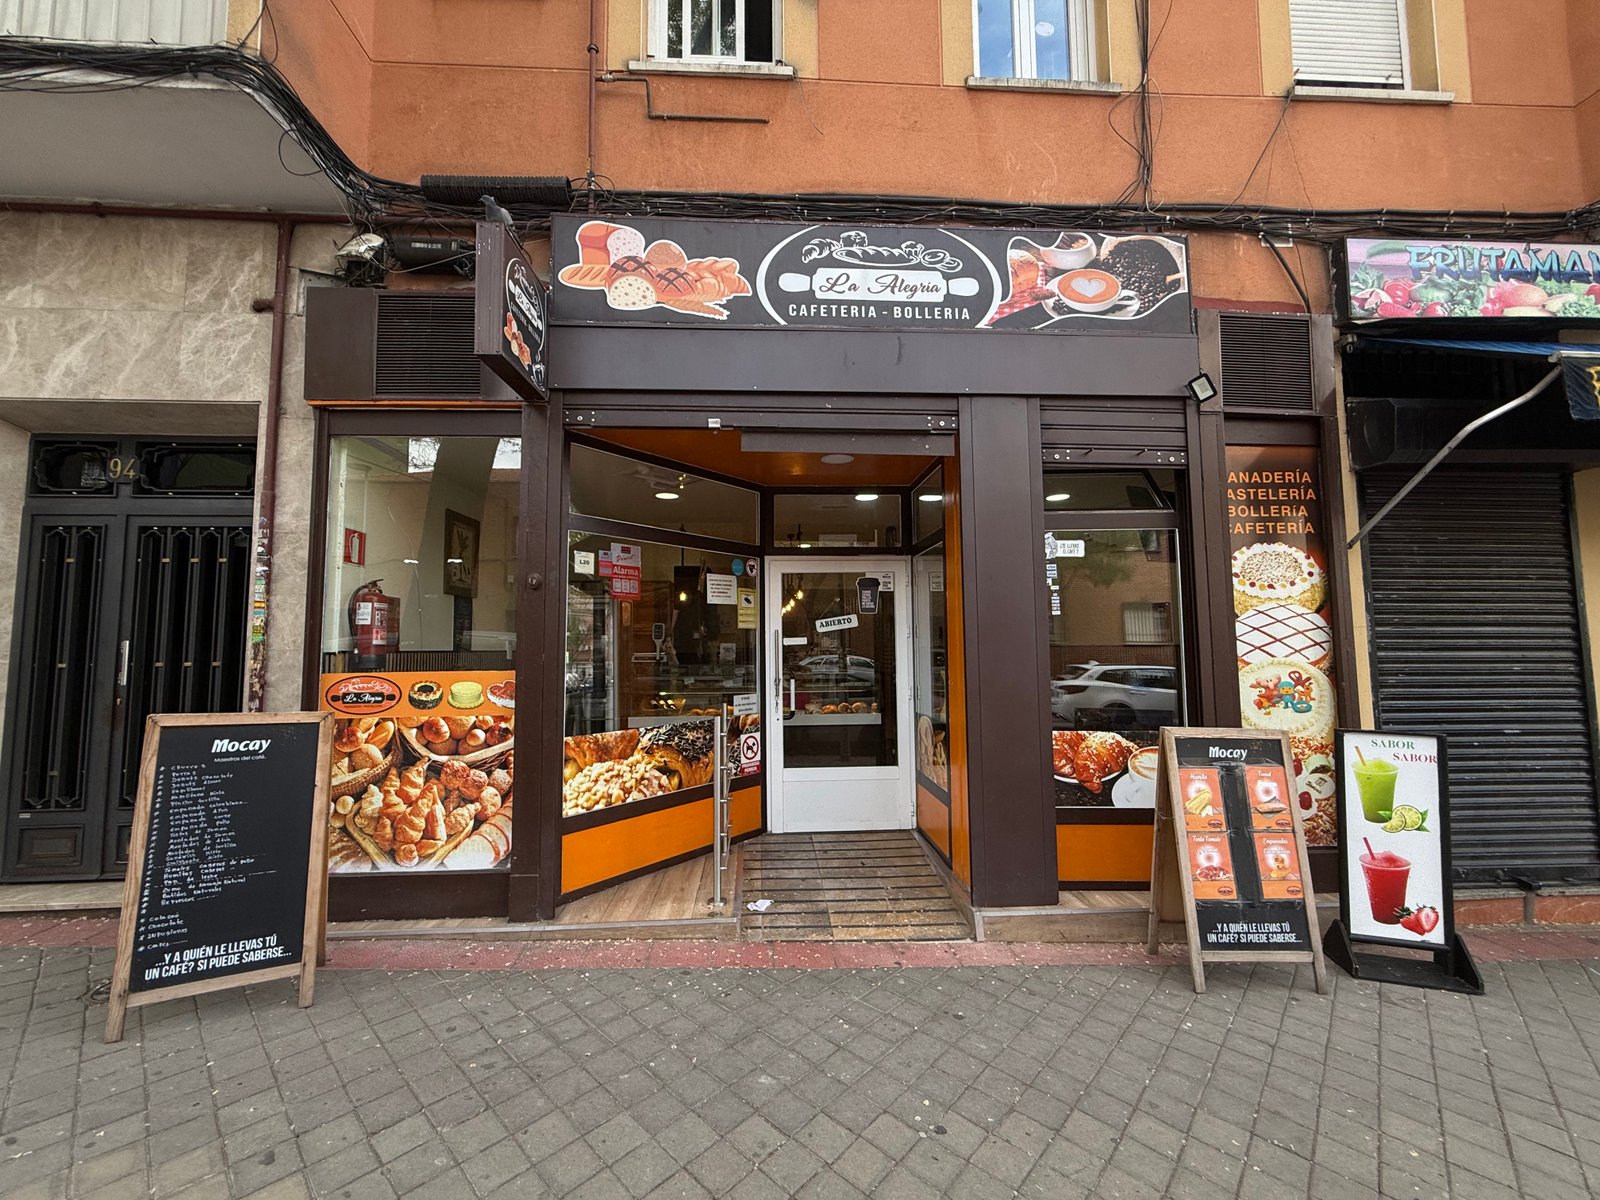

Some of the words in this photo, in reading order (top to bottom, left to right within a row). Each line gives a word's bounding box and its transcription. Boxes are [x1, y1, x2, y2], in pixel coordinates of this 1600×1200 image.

[819, 272, 859, 294] La
[788, 304, 877, 318] CAFETERIA
[893, 306, 970, 320] BOLLERIA
[109, 458, 136, 479] 94
[1227, 469, 1312, 483] ANADERÍA
[1227, 486, 1316, 500] ASTELERÍA
[1229, 519, 1315, 534] AFETERÍA
[613, 566, 639, 576] Alarma
[819, 617, 853, 628] ABIERTO
[211, 738, 271, 753] Mocay
[1371, 739, 1415, 750] SABOR
[1208, 746, 1248, 761] Mocay
[1393, 752, 1437, 764] SABOR
[1223, 923, 1229, 933] A
[1229, 921, 1248, 933] QUIÉN
[1249, 923, 1257, 933] LE
[1257, 923, 1281, 933] LLEVAS
[1281, 921, 1291, 933] TÚ
[1207, 933, 1217, 943] UN
[1216, 931, 1238, 943] CAFÉ?
[1240, 933, 1247, 943] SI
[1247, 933, 1268, 943] PUEDE
[173, 952, 181, 963] A
[183, 945, 213, 961] QUIÉN
[214, 943, 228, 956] LE
[228, 939, 263, 954] LLEVAS
[265, 933, 278, 947] TÚ
[145, 967, 160, 981] UN
[161, 960, 194, 978] CAFÉ?
[197, 959, 207, 971] SI
[208, 953, 241, 969] PUEDE
